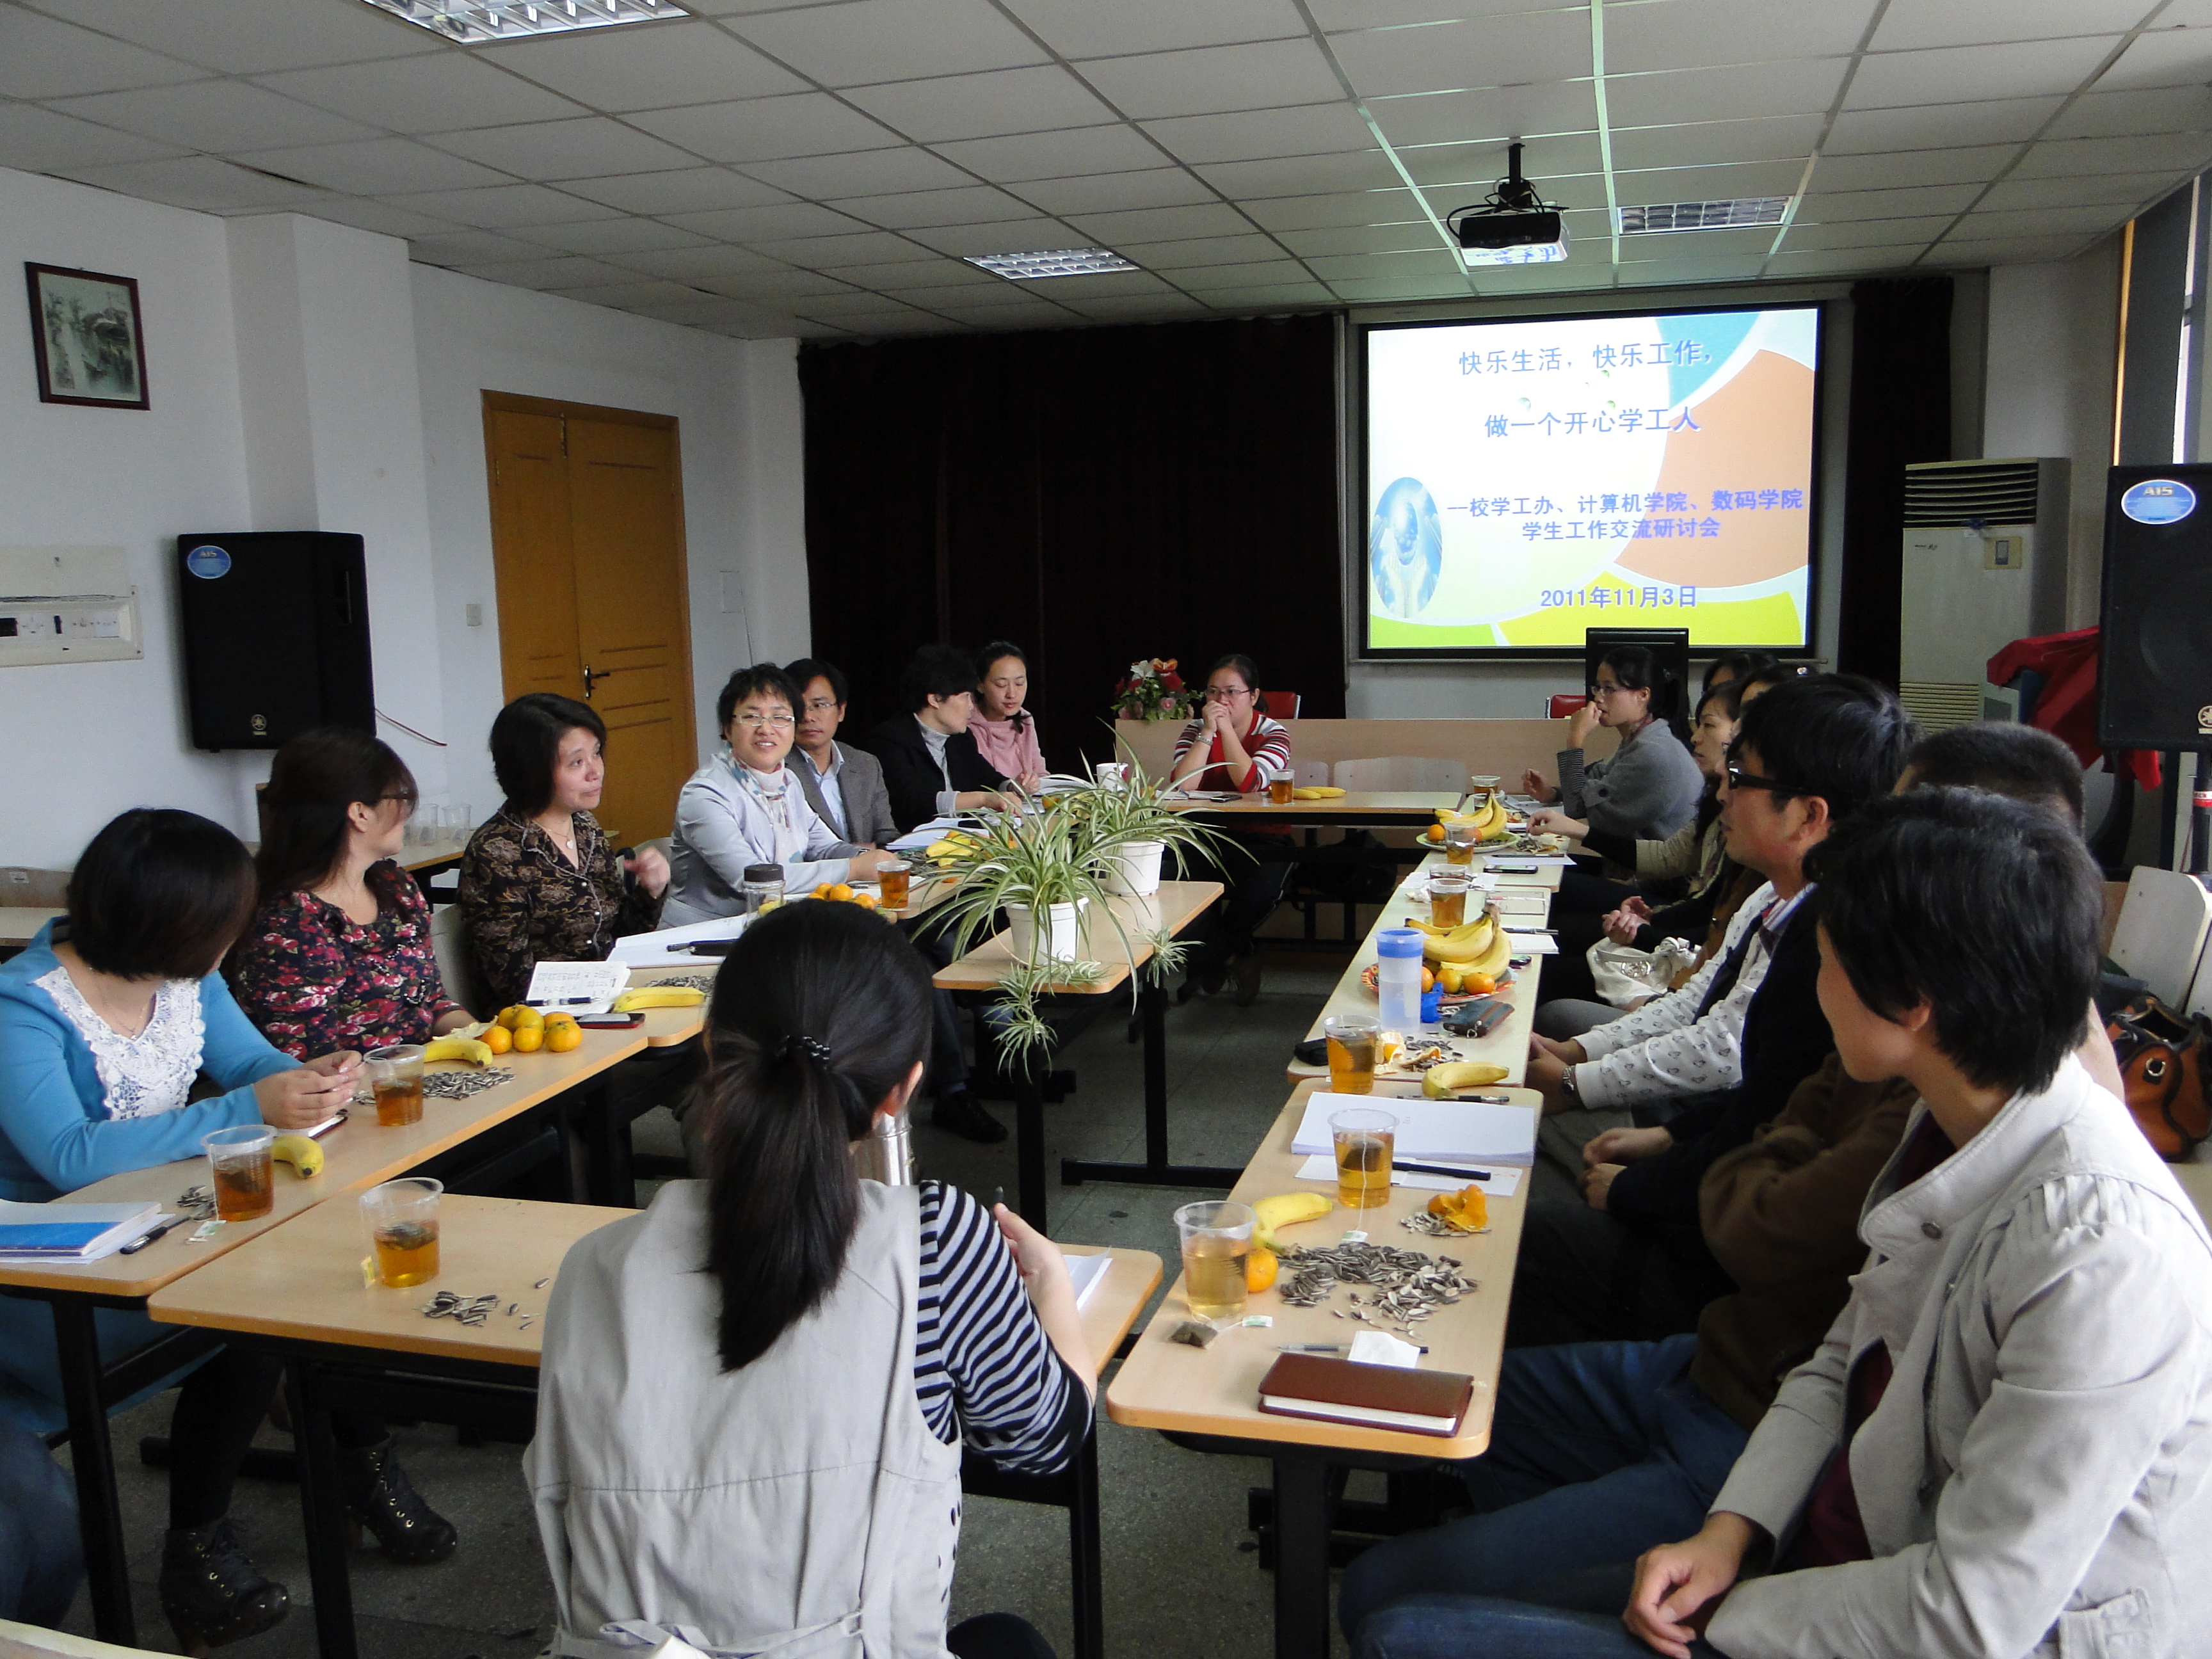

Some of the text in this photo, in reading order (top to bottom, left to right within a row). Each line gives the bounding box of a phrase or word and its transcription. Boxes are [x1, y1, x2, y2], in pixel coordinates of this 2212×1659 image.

[1484, 406, 1700, 438] 做一个开心学工人
[2144, 486, 2174, 496] A15
[1522, 516, 1721, 541] 学生工作交流研讨会
[1540, 585, 1697, 609] 2011年11月3日
